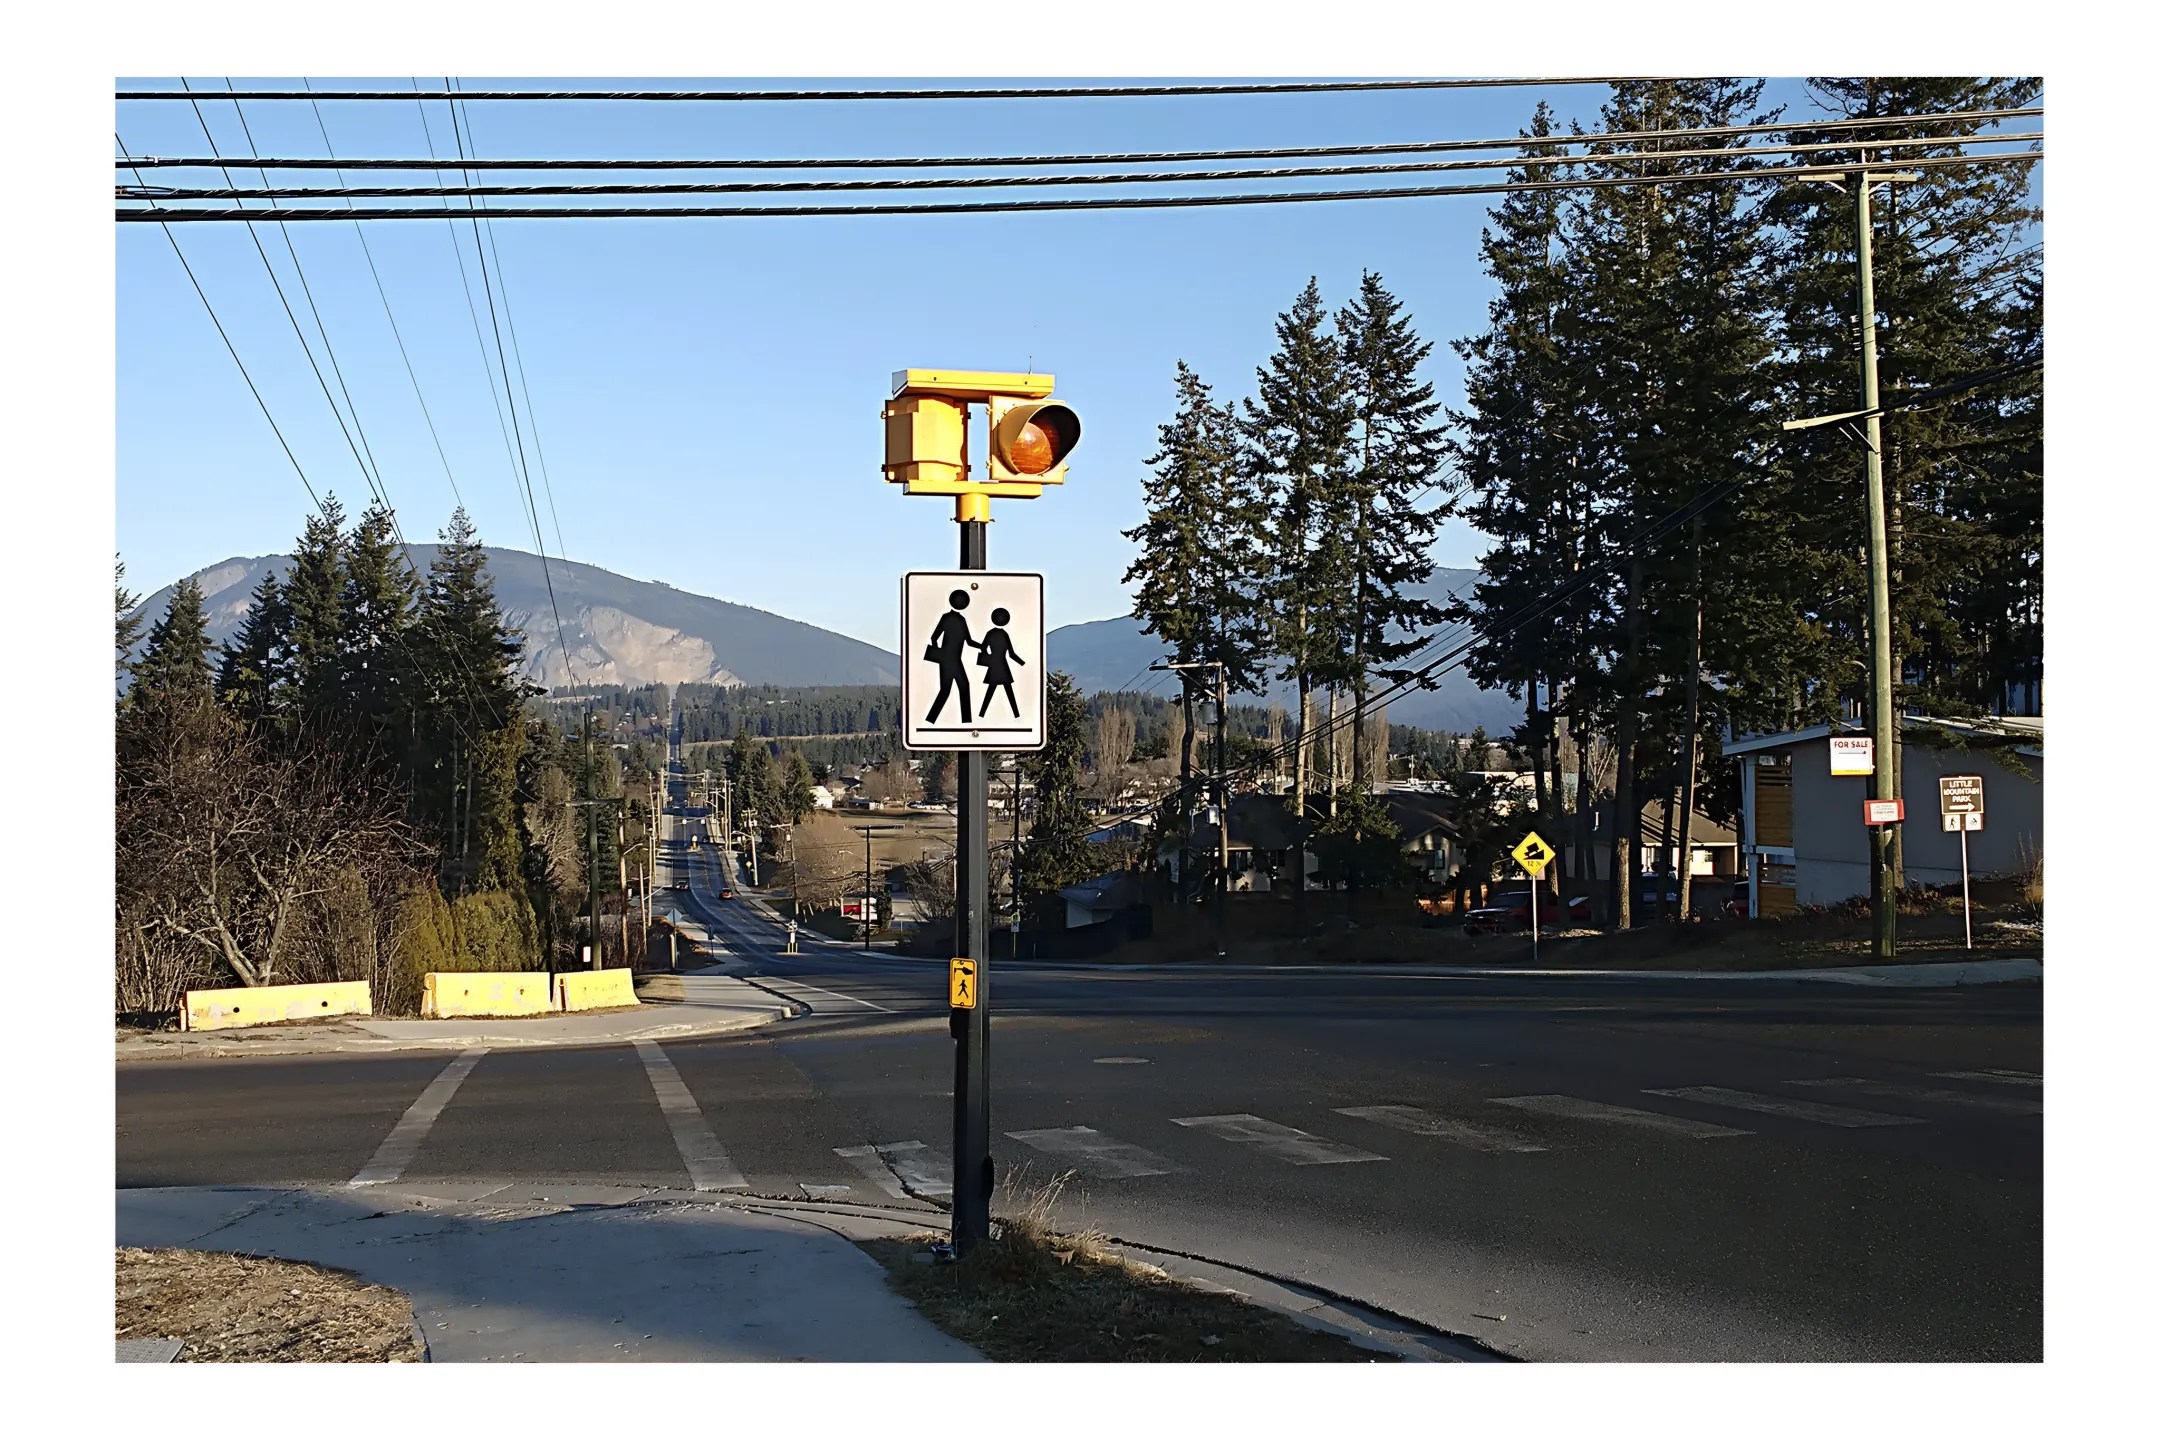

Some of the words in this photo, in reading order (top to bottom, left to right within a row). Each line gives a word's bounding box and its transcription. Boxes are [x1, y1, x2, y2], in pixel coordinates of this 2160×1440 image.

[1851, 740, 1868, 748] SALE
[1949, 780, 1973, 788] LITTLE
[1943, 788, 1980, 796] MOUNTAIN
[1952, 795, 1972, 803] PARK
